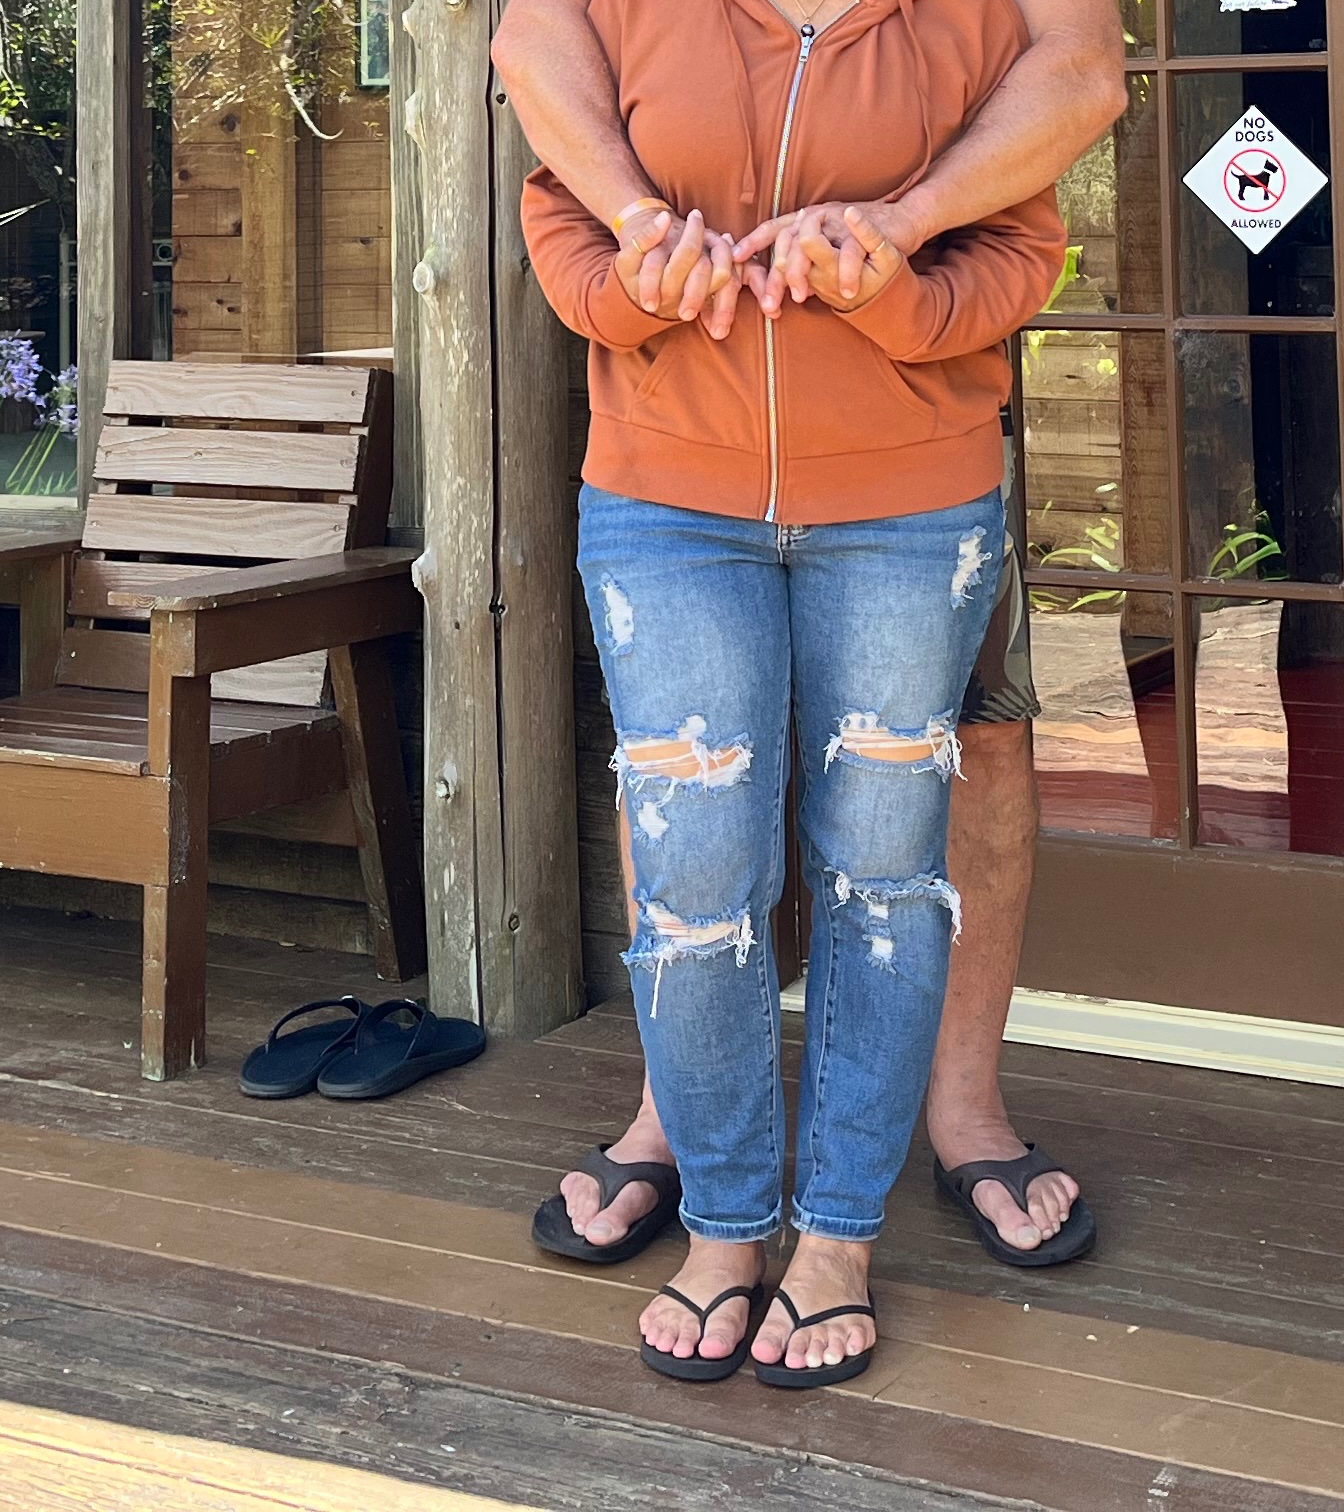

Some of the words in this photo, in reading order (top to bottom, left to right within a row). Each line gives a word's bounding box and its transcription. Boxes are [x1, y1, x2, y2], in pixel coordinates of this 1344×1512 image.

[1243, 117, 1266, 129] NO
[1235, 130, 1275, 142] DOGS
[1230, 218, 1282, 229] ALLOWED
